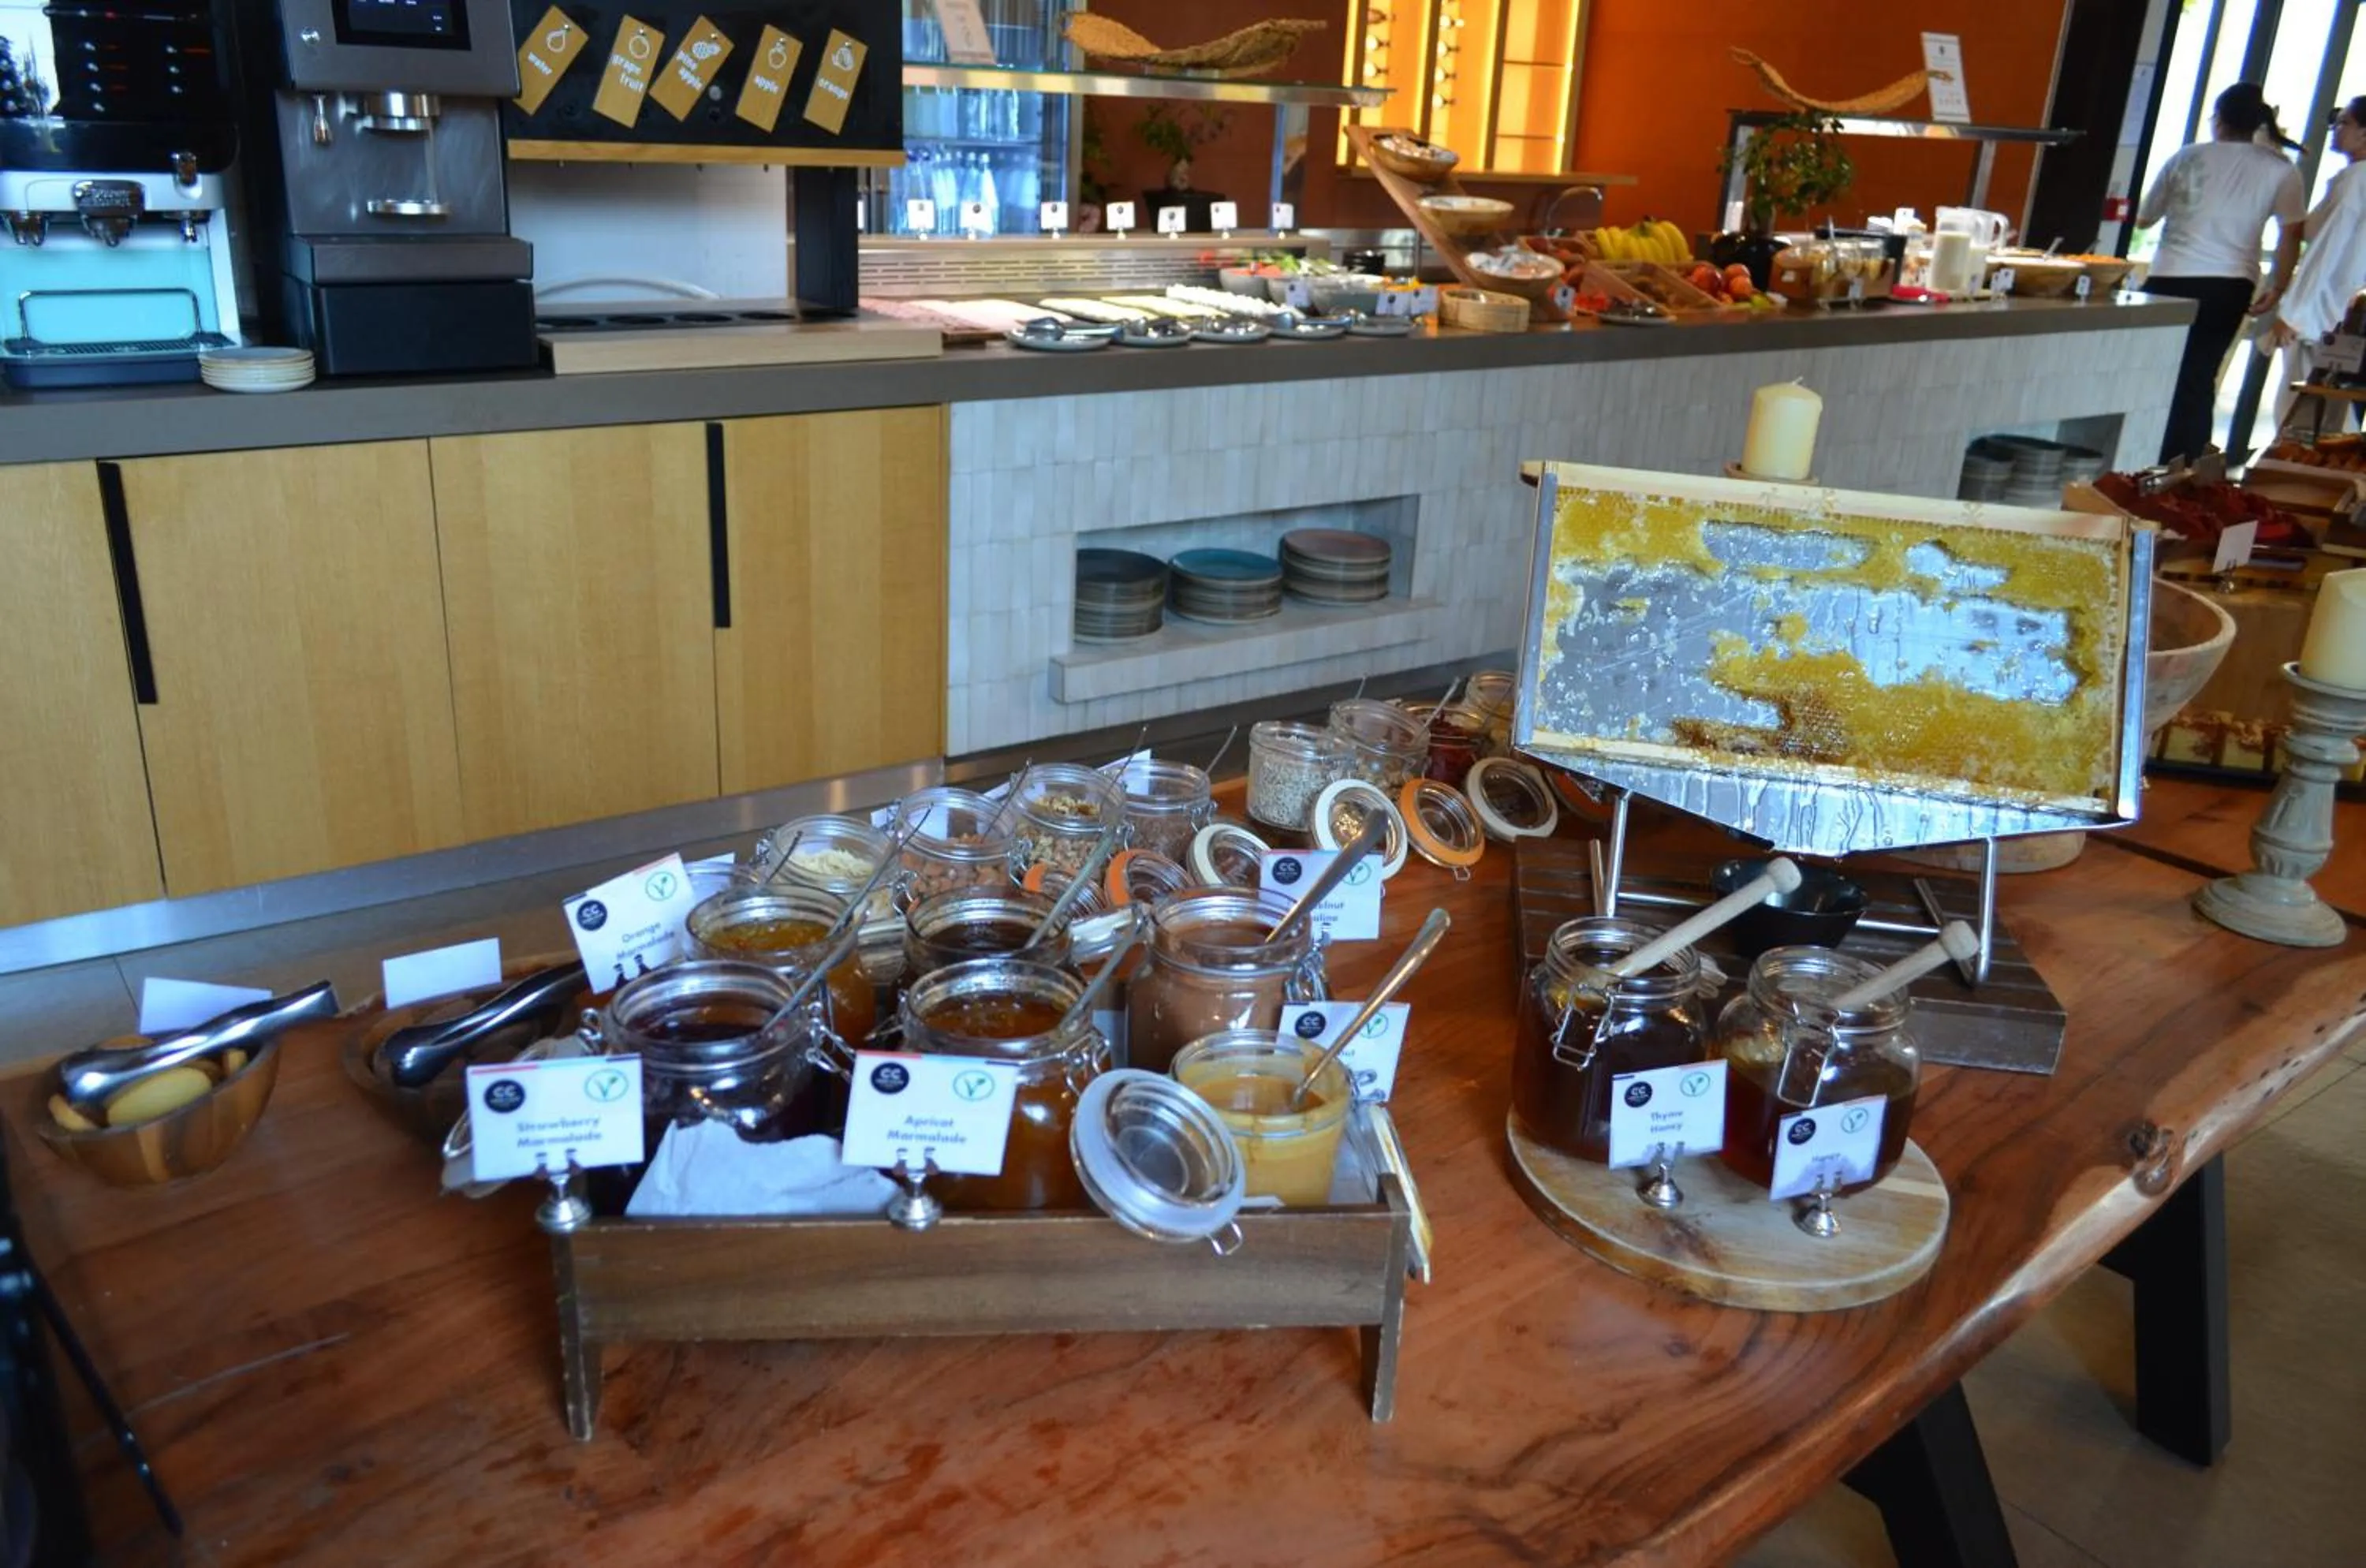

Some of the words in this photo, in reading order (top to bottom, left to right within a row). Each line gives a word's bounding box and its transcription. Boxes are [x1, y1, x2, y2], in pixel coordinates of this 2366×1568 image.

[621, 922, 661, 943] Orange
[904, 1116, 954, 1129] Apricot
[1651, 1111, 1684, 1121] Thyme
[517, 1116, 599, 1133] Strawberry
[1651, 1123, 1683, 1133] Honey
[517, 1130, 602, 1148] Marmalade
[886, 1129, 967, 1144] Marmalade
